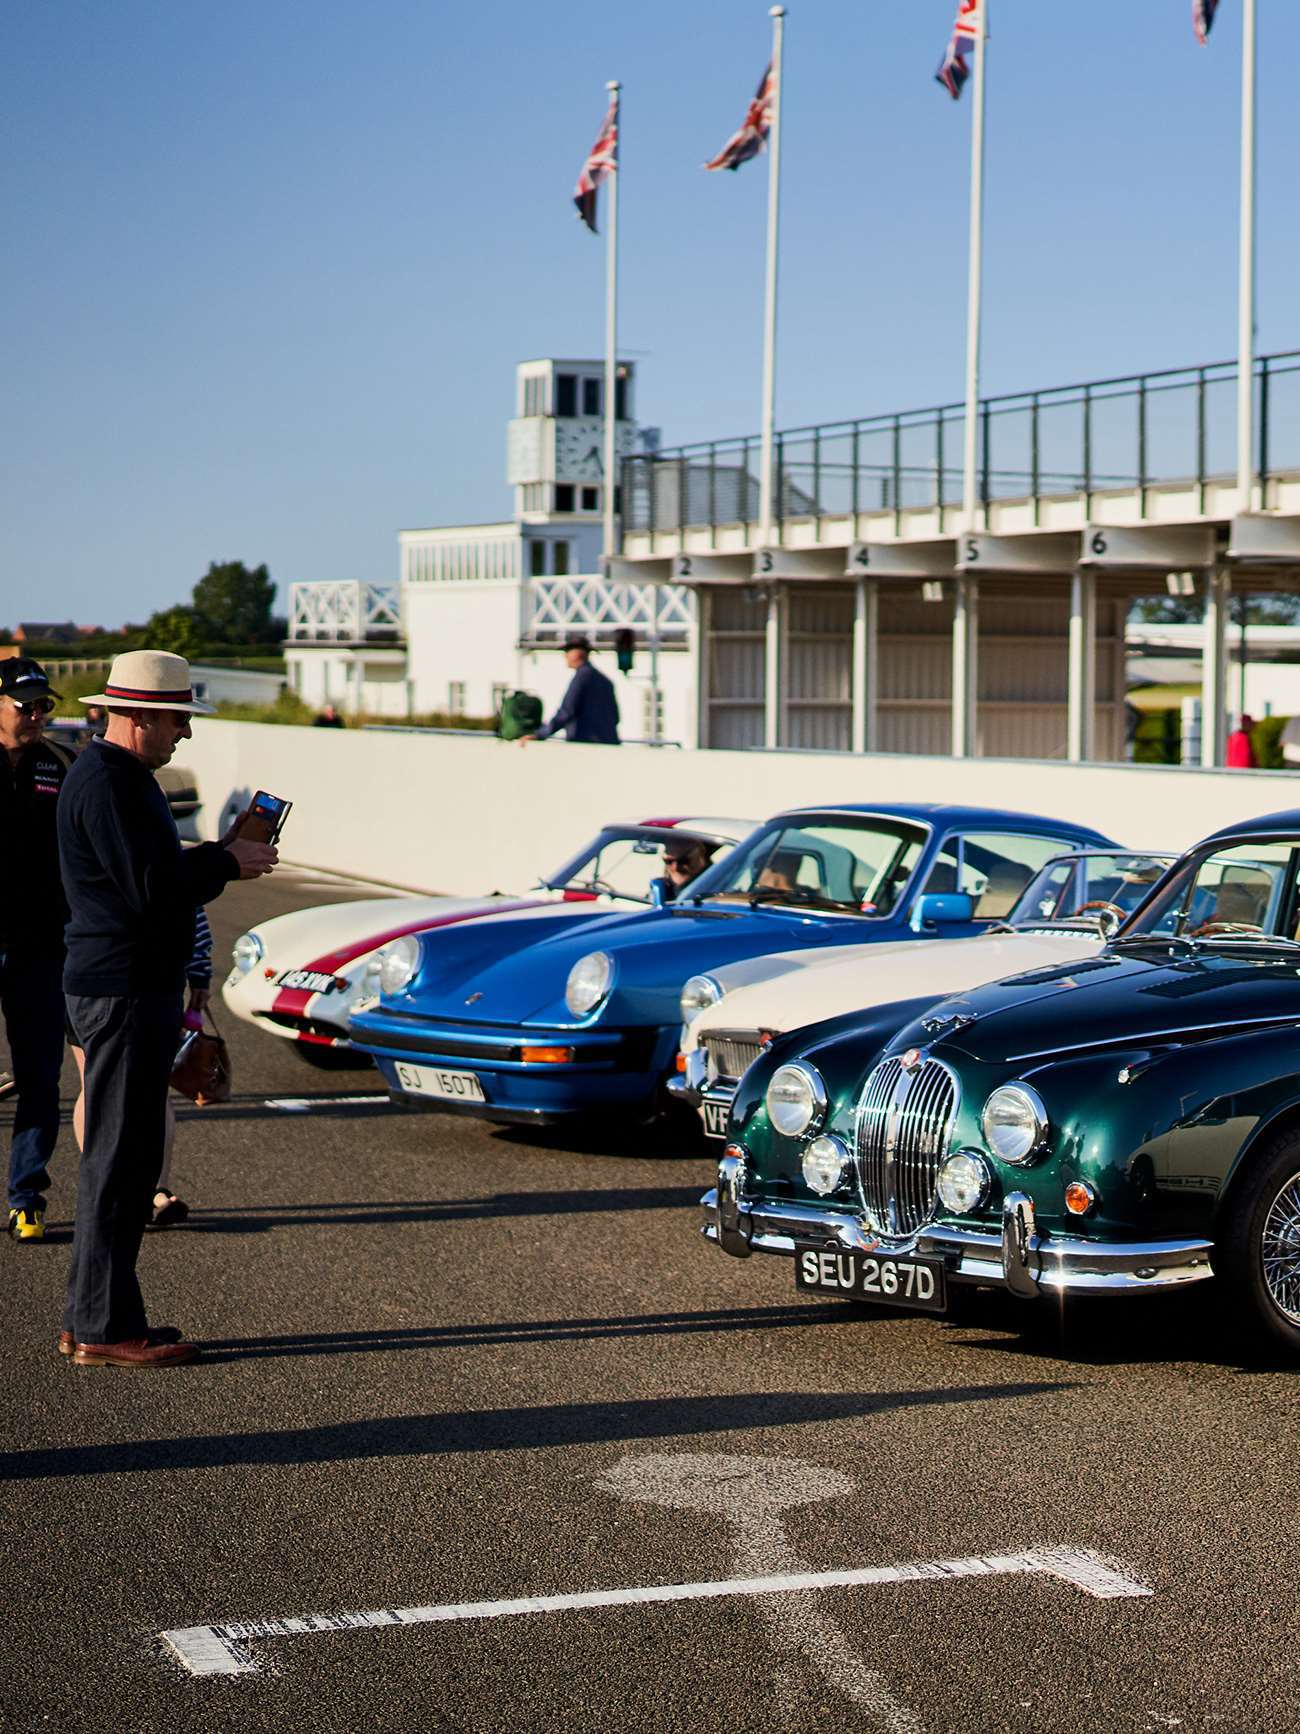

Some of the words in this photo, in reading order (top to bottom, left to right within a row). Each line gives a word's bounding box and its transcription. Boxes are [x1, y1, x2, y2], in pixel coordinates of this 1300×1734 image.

[967, 540, 979, 561] 5
[1091, 531, 1107, 554] 6
[680, 556, 691, 576] 2
[762, 551, 773, 572] 3
[855, 547, 869, 566] 4
[400, 1067, 422, 1088] SJ
[801, 1251, 856, 1289] SEU
[862, 1258, 935, 1300] 267D
